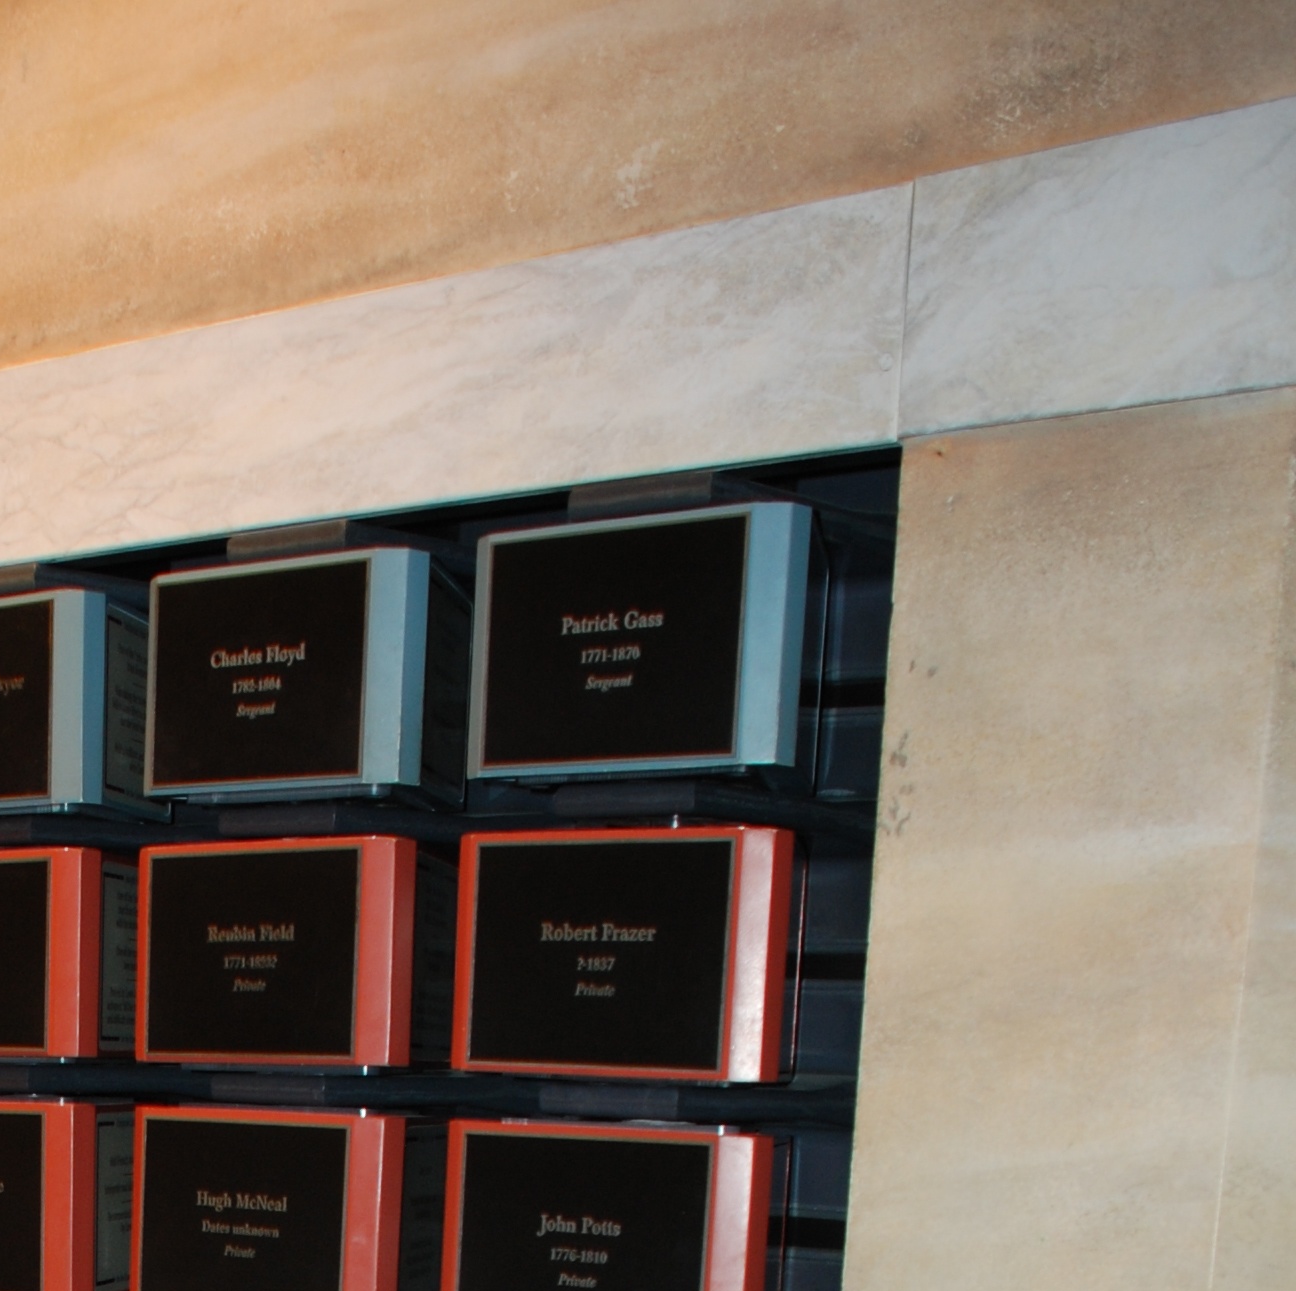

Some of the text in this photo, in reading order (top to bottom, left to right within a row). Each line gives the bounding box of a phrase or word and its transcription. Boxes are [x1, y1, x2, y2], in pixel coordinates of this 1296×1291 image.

[561, 611, 664, 635] Patrick Gass
[210, 642, 306, 669] Charles Floyd
[581, 647, 641, 664] 1771-1870
[585, 673, 633, 692] Sergeant
[207, 923, 295, 943] Reubin Field
[540, 921, 657, 942] Robert Frazer
[577, 955, 616, 971] ?-1837
[575, 980, 616, 998] Private
[196, 1190, 288, 1213] Hugh McNeal
[201, 1218, 280, 1239] Dates unknown
[537, 1213, 622, 1238] John Potts
[224, 1244, 256, 1259] Private
[550, 1247, 609, 1265] 1776-1810
[556, 1272, 598, 1289] Private
